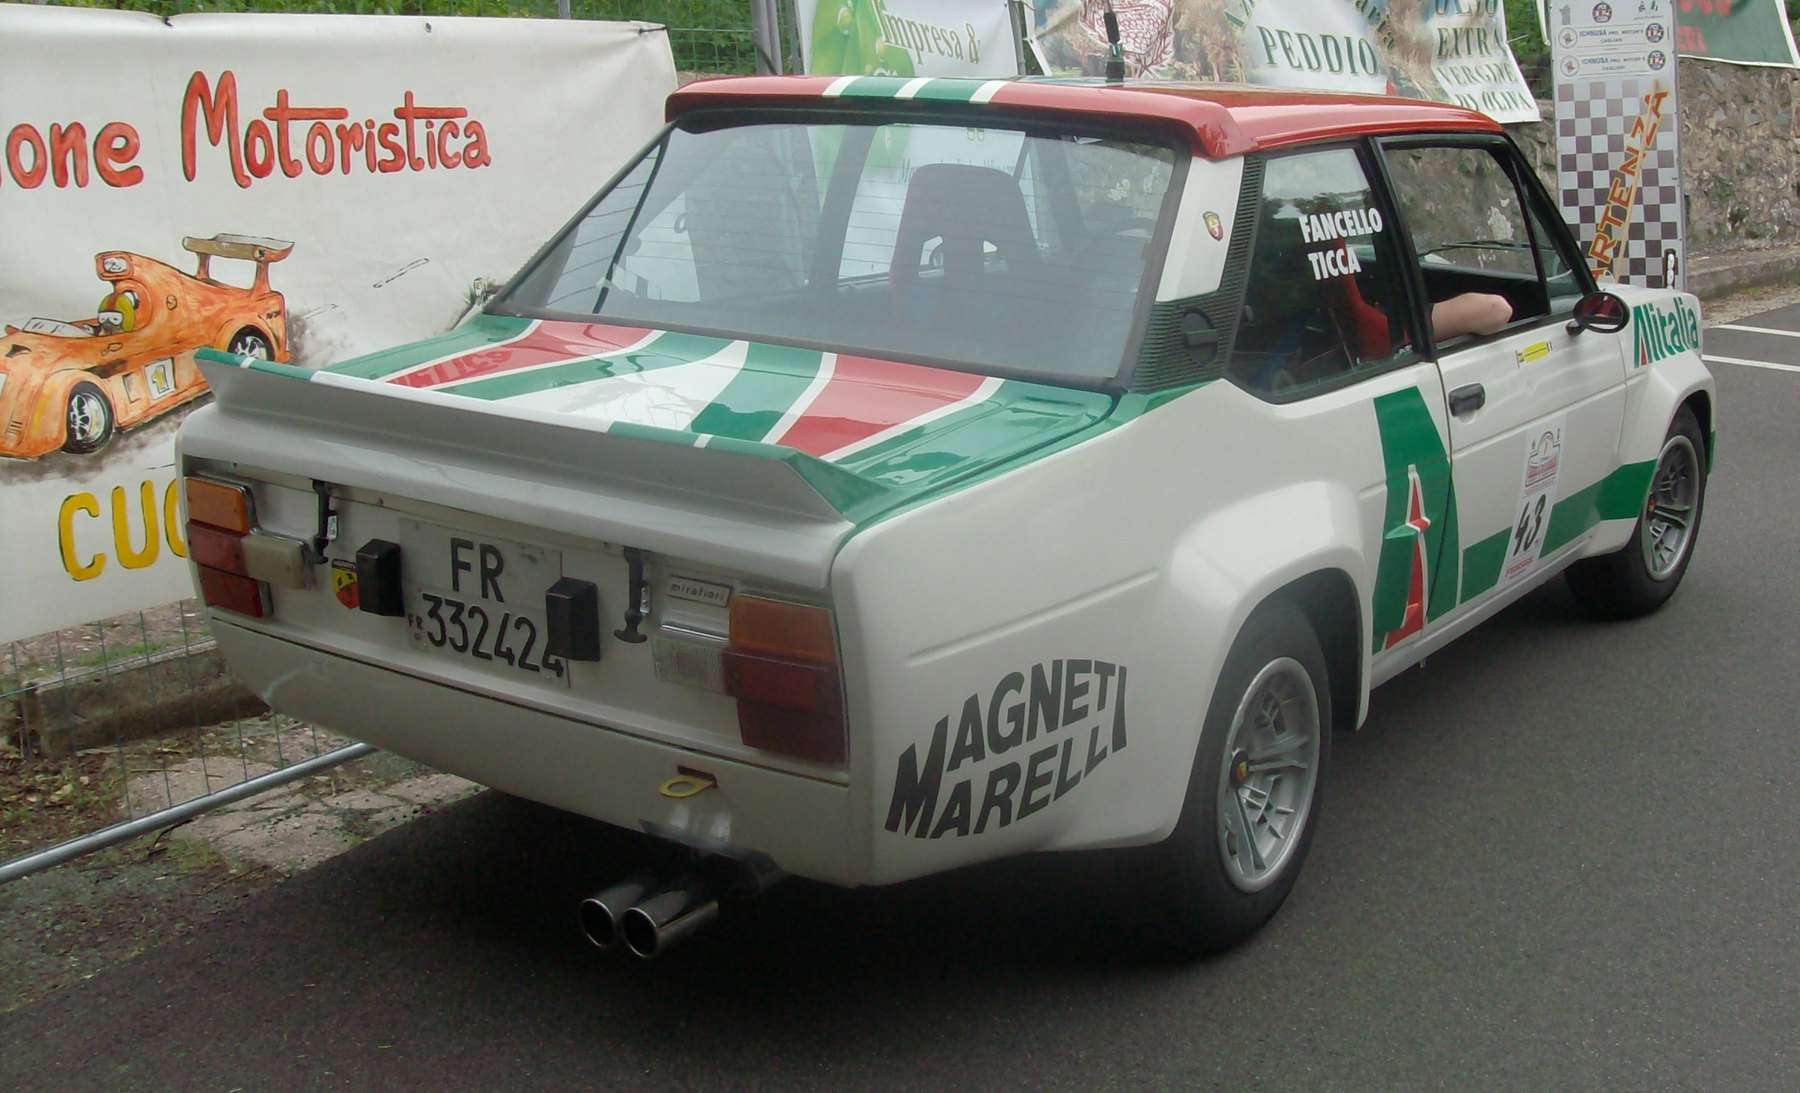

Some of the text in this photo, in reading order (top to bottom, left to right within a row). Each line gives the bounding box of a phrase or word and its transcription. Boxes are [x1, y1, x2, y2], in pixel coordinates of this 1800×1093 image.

[872, 0, 981, 65] Impresa &
[1257, 26, 1377, 76] PEDDIO
[1437, 27, 1508, 58] EXTRA
[1437, 63, 1517, 85] VERGINE
[0, 70, 491, 188] one Motoristica
[1299, 207, 1383, 244] FANCELLO
[1307, 246, 1362, 281] TICCA
[1633, 296, 1700, 369] Alitalia
[1513, 493, 1547, 557] 43
[451, 537, 504, 603] FR
[422, 593, 564, 678] 332424
[885, 659, 1127, 839] MAGNETI
